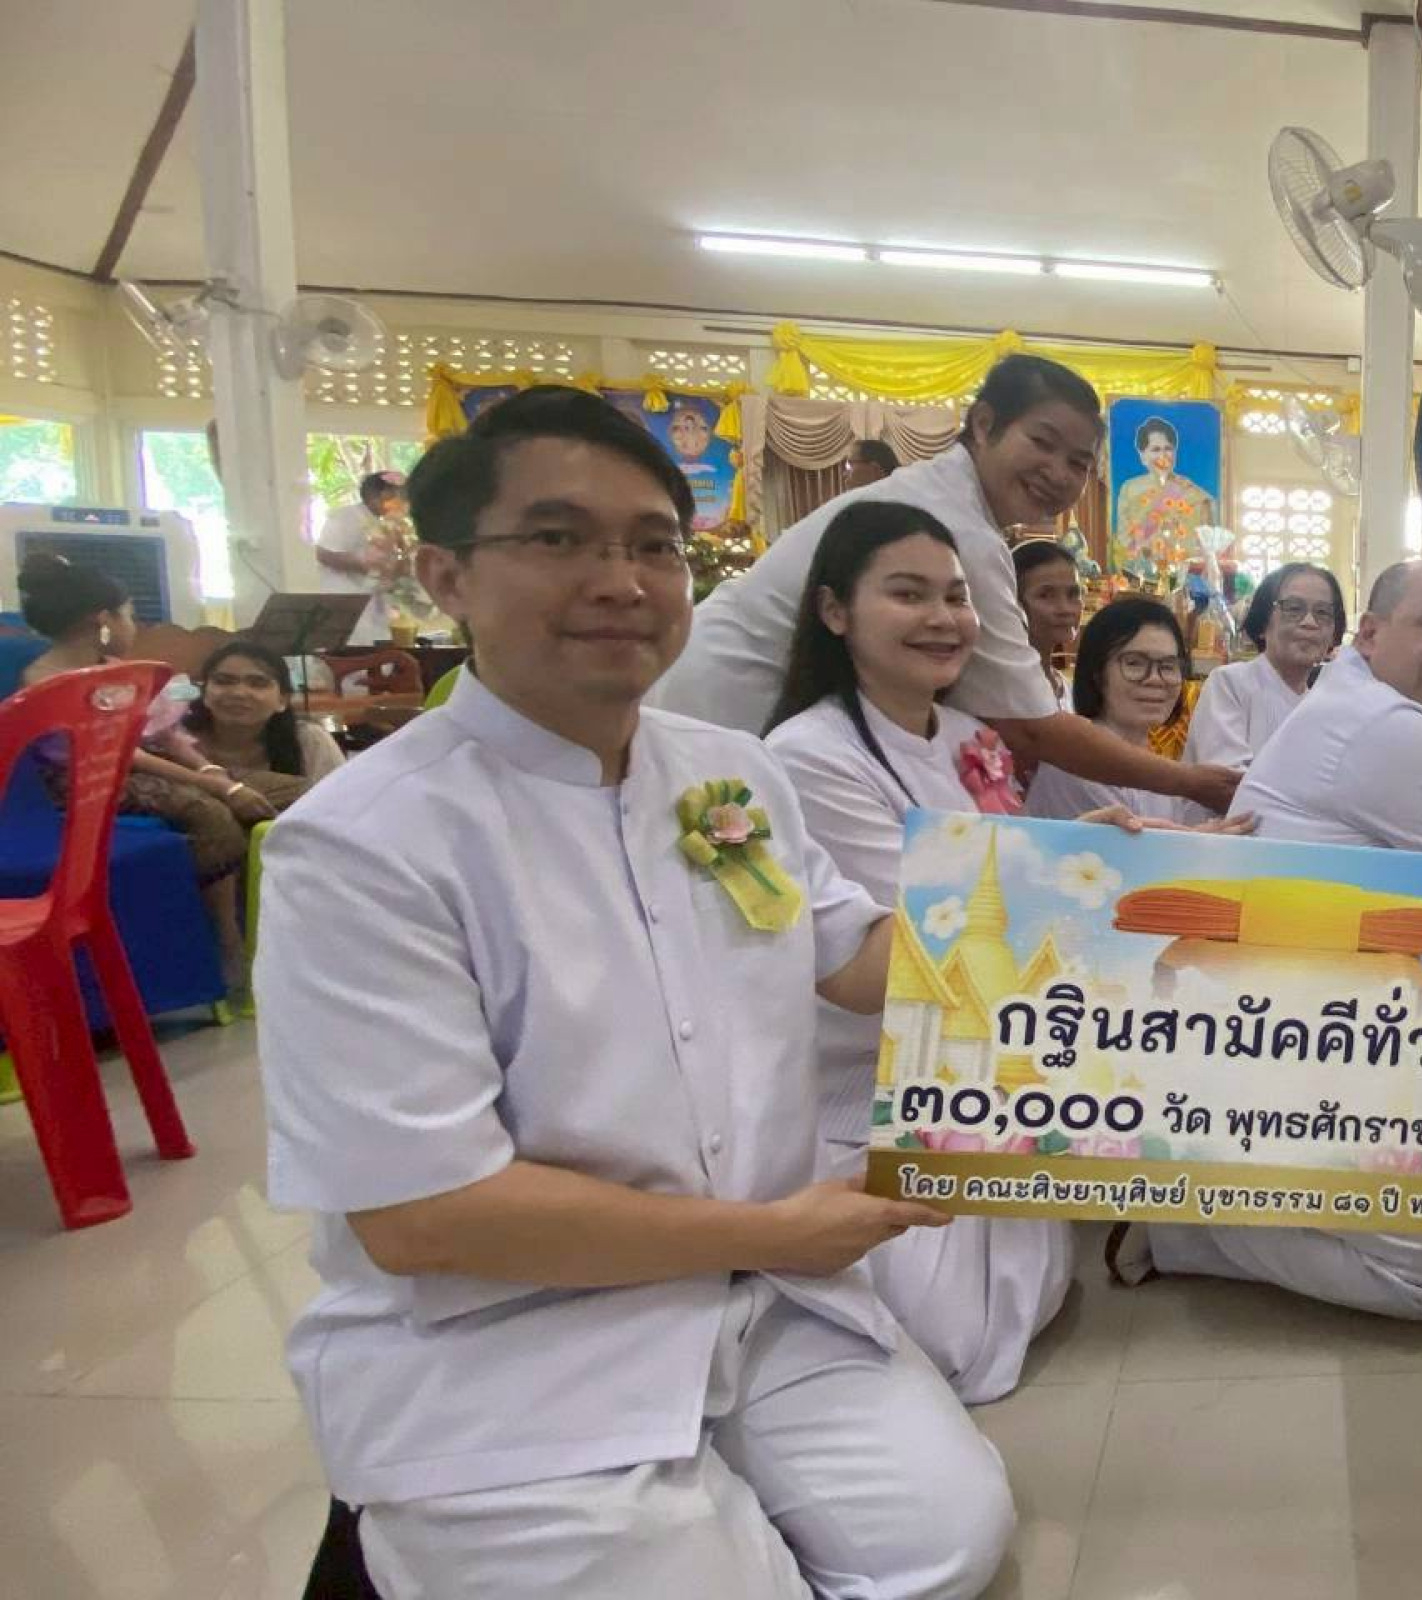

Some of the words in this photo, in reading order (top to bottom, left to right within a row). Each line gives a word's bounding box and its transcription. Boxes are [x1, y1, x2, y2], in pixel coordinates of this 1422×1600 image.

[900, 1085, 1144, 1135] ๓๐,๐๐๐
[1162, 1093, 1211, 1134] วัด
[901, 1167, 954, 1197] โดย
[966, 1174, 1188, 1211] คณะศิษยานุศิษย์
[1198, 1187, 1323, 1214] บูชาธรรม
[1333, 1194, 1371, 1214] ๘๑
[1382, 1187, 1400, 1214] ปี
